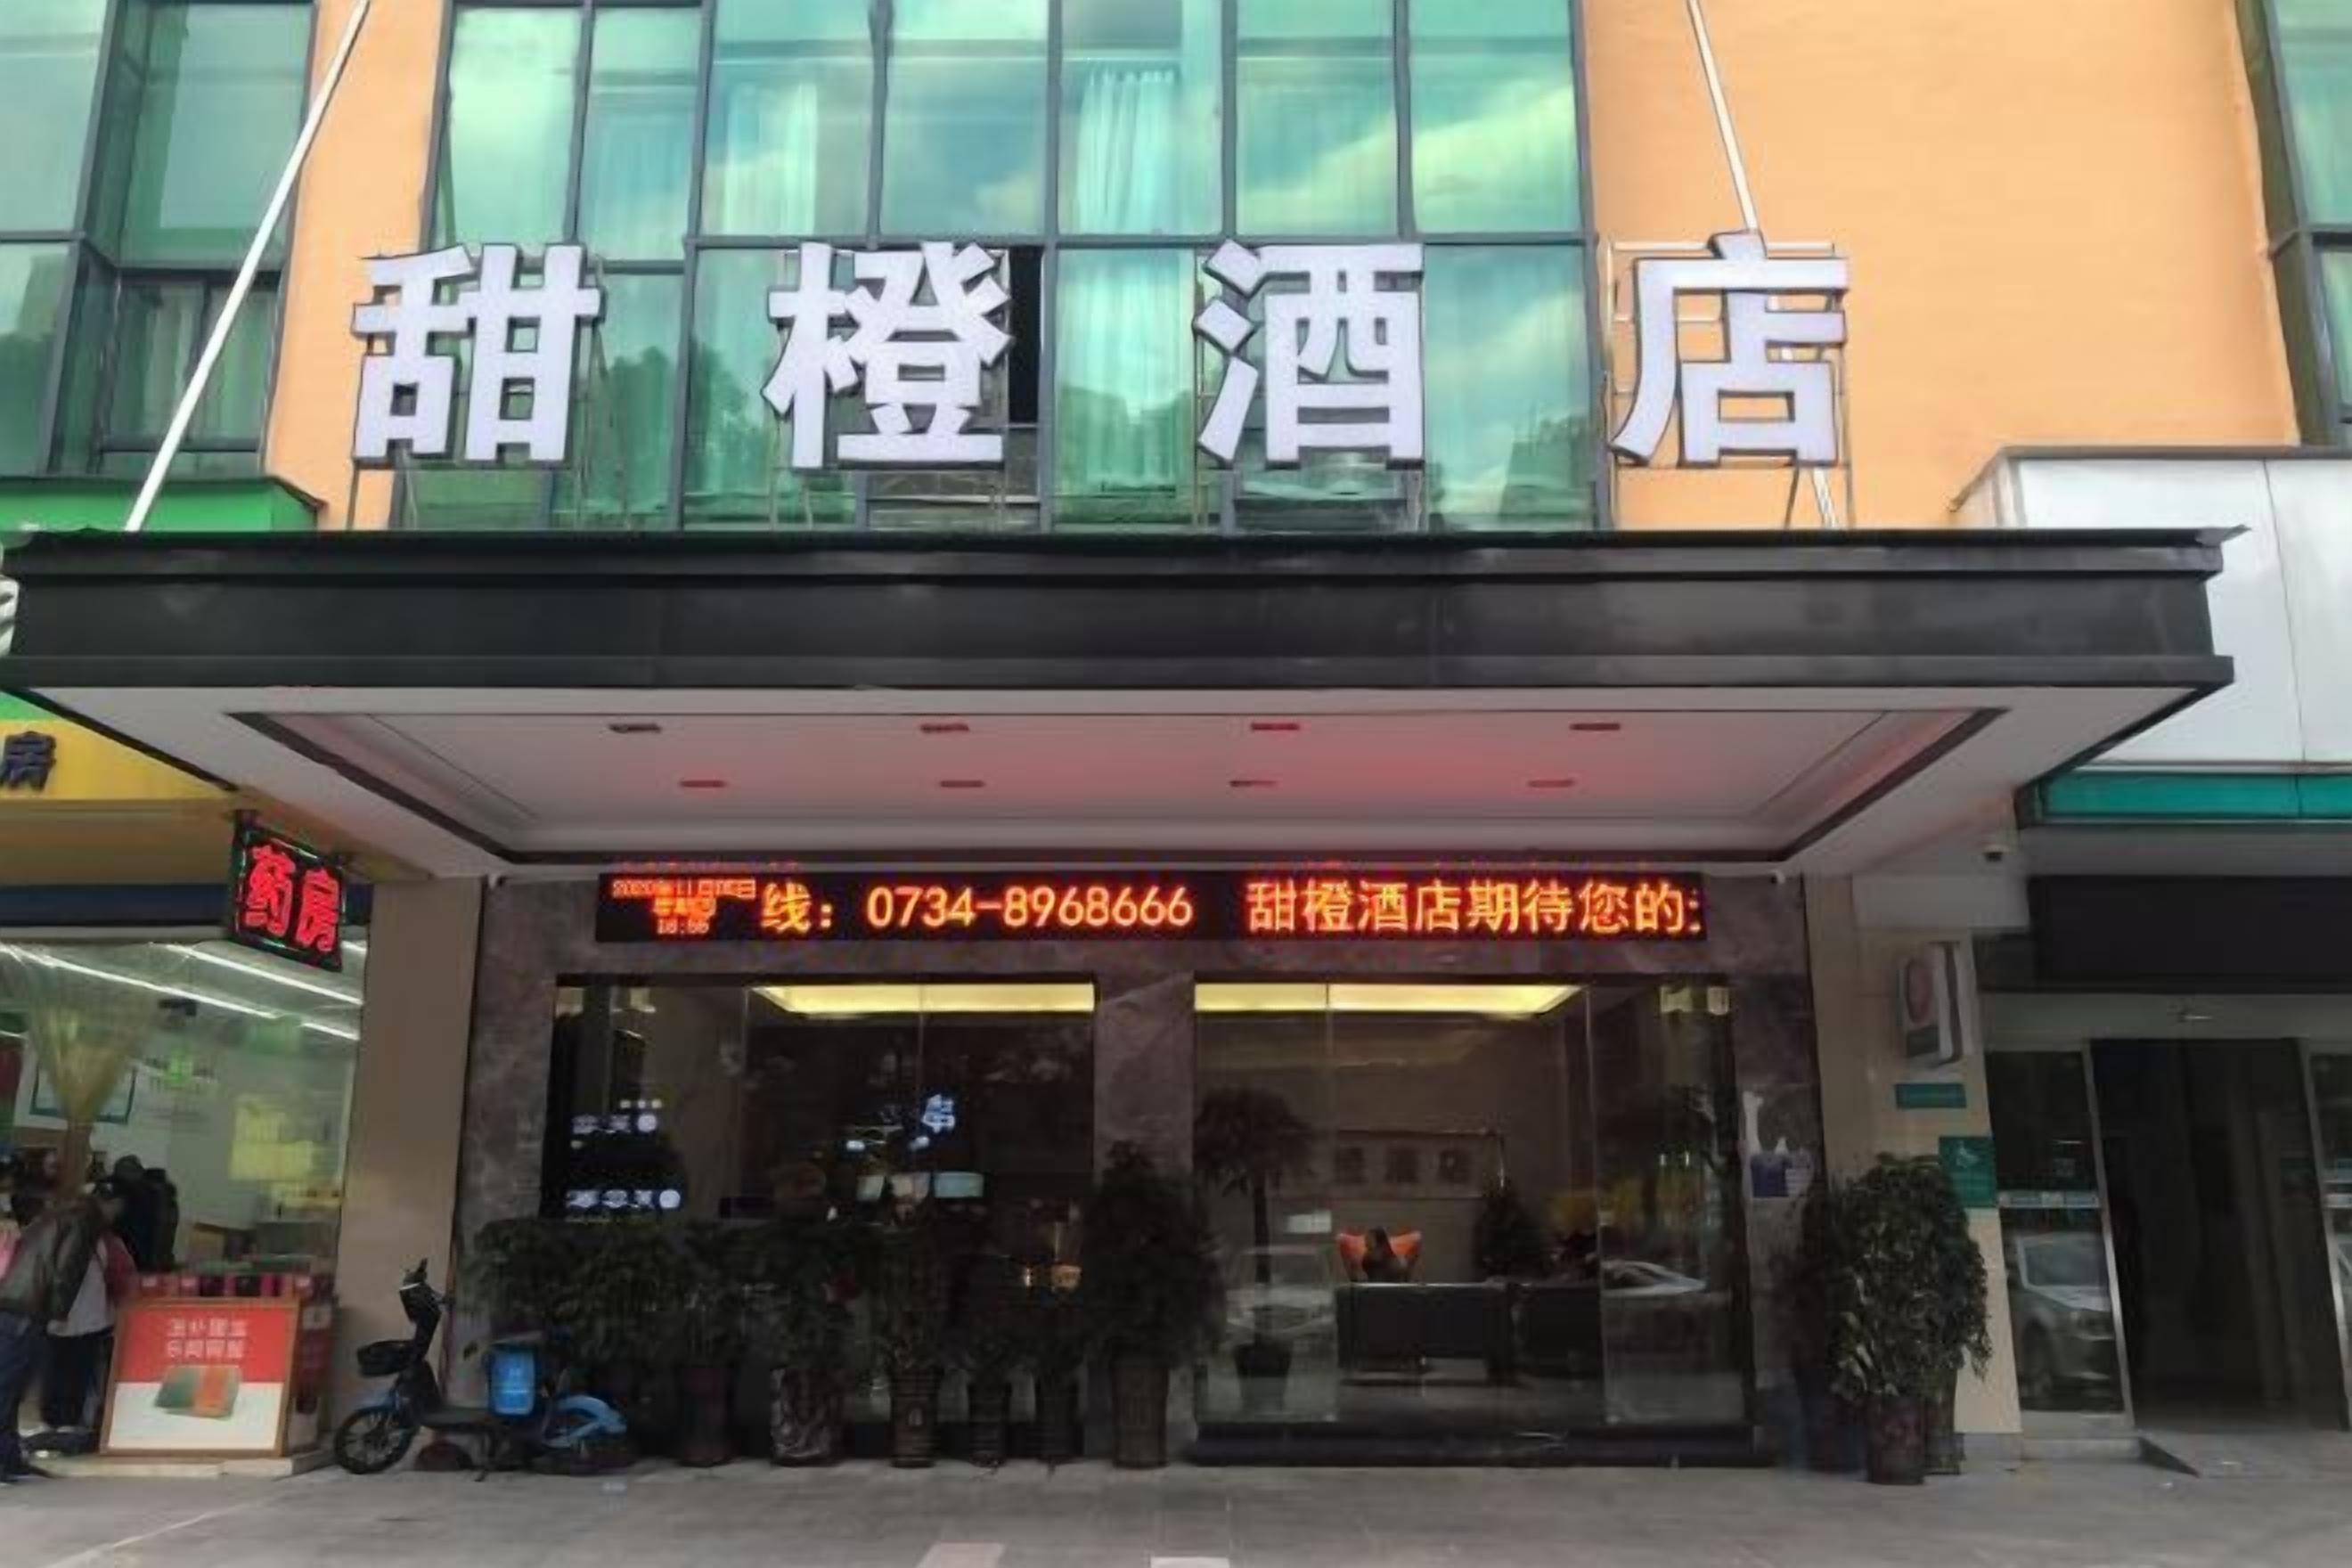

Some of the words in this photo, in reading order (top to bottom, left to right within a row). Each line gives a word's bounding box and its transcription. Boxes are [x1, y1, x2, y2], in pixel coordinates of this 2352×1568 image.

[354, 233, 1850, 468] 甜橙酒店
[244, 845, 340, 952] 药房
[1246, 878, 1701, 935] 甜橙酒店期待您的
